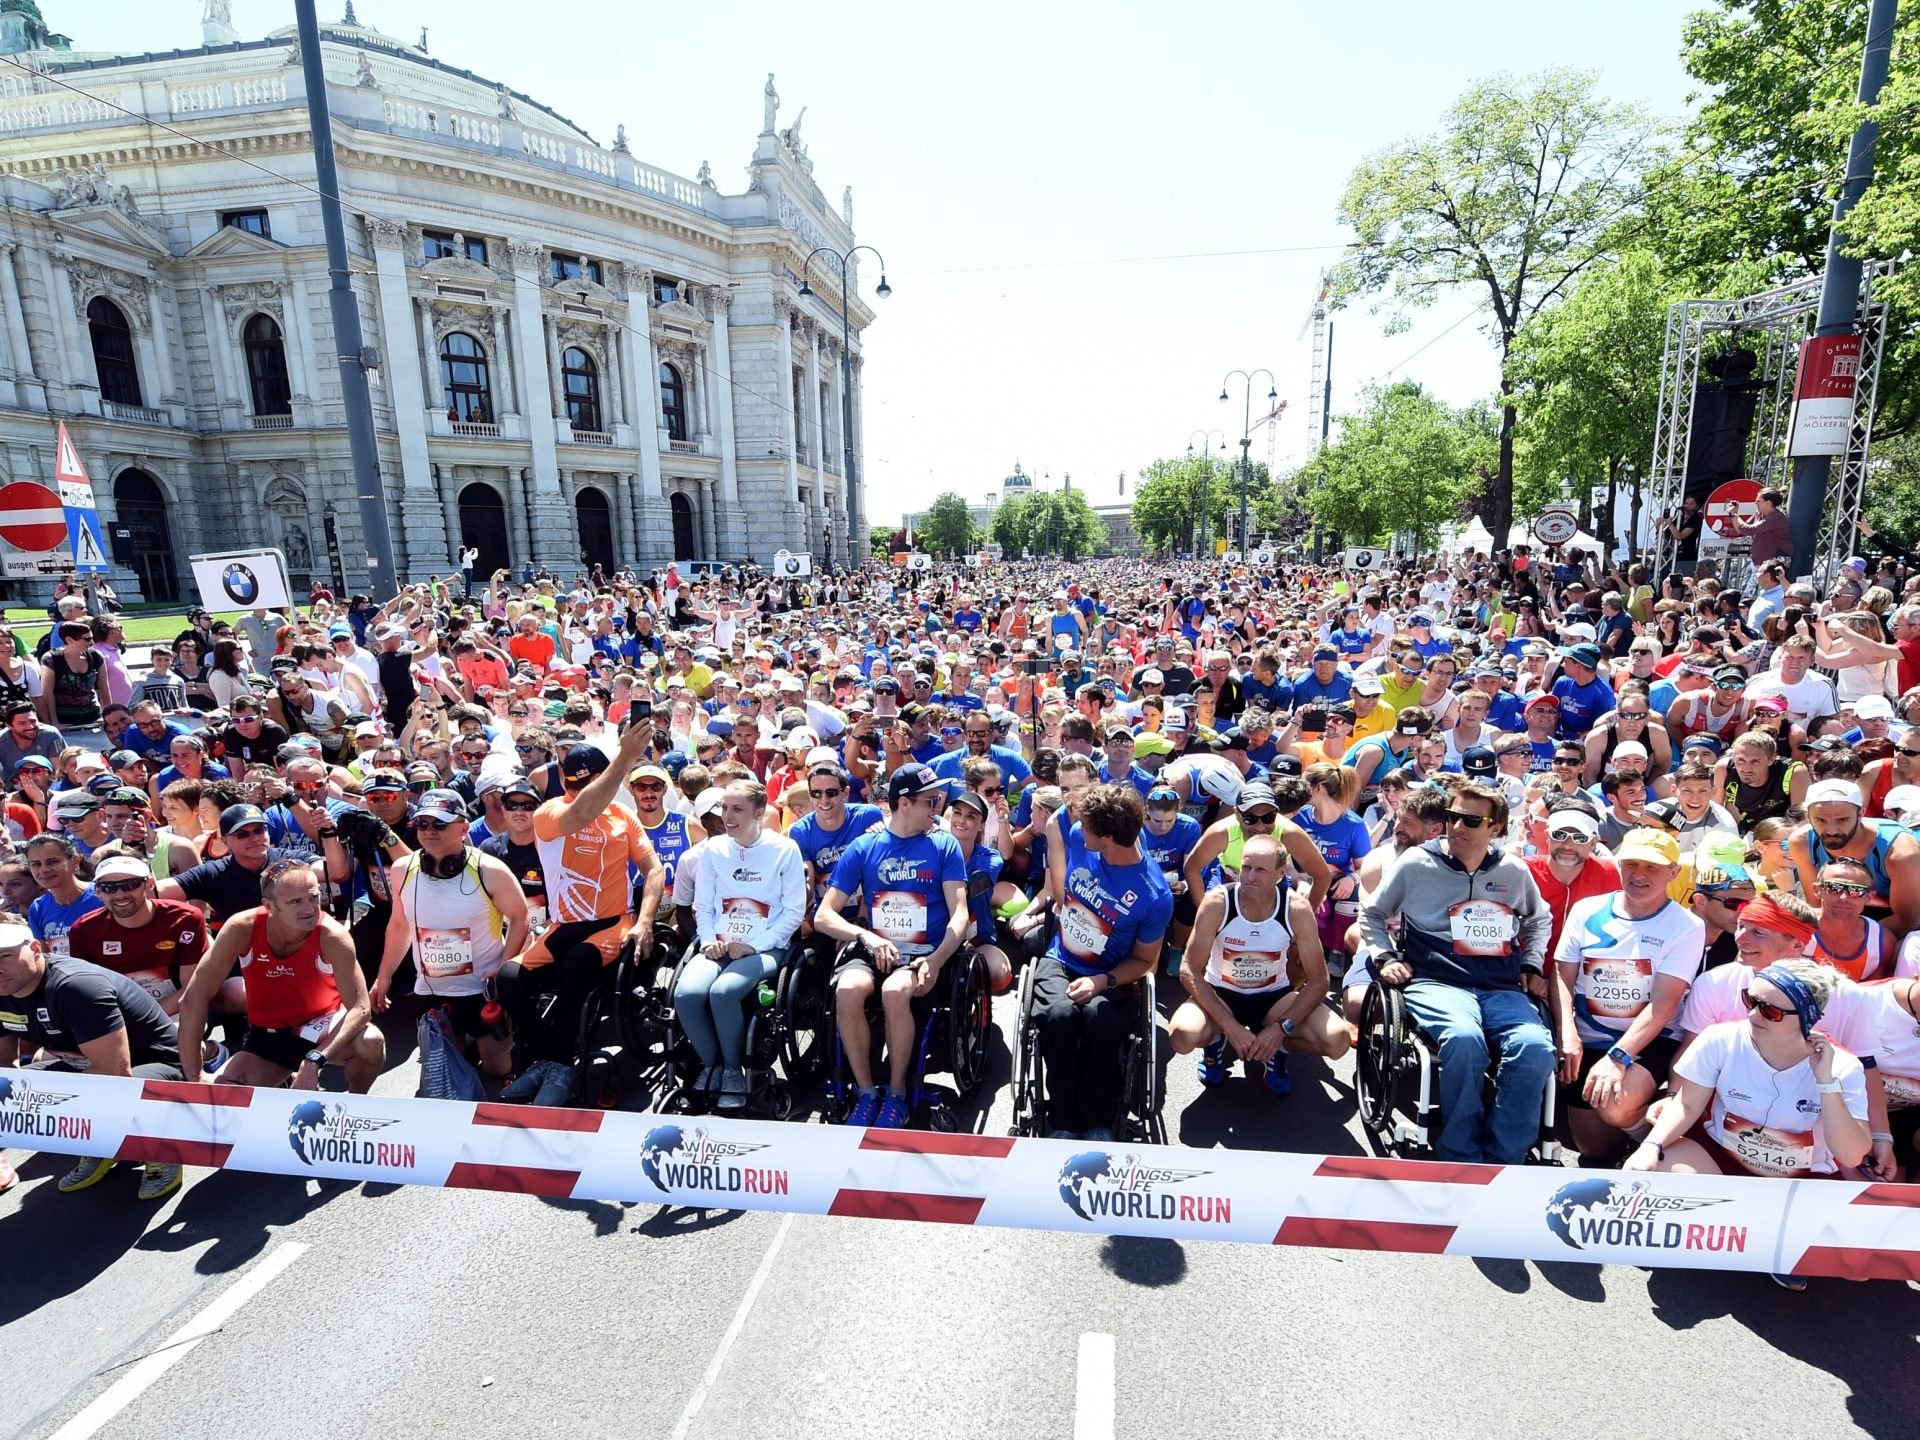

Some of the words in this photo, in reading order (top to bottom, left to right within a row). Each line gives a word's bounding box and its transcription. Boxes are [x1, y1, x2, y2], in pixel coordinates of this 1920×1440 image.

[1821, 378, 1856, 389] TEEHA
[7, 560, 36, 571] ausgen.
[224, 563, 252, 579] BMW
[823, 852, 841, 864] WORL
[889, 869, 917, 882] WORLD
[1074, 881, 1103, 909] WORLD
[727, 922, 754, 935] 7937
[883, 917, 913, 929] 2144
[1063, 919, 1095, 948] 91309
[1463, 925, 1503, 938] 76088
[423, 952, 462, 964] 20880
[1231, 968, 1268, 979] 25651
[1592, 986, 1641, 1001] 22956
[1602, 1002, 1633, 1011] Herbert
[13, 1089, 54, 1104] WINGS
[20, 1102, 43, 1114] LIFE
[0, 1110, 57, 1137] WORLD
[58, 1115, 92, 1141] RUN
[326, 1115, 372, 1130] WINGS
[333, 1127, 360, 1140] LIFE
[309, 1137, 375, 1165] WORLD
[377, 1142, 416, 1169] RUN
[684, 1140, 737, 1155] WINGS
[1736, 1143, 1797, 1167] 52146
[692, 1152, 723, 1166] LIFE
[665, 1162, 741, 1192] WORLD
[744, 1168, 789, 1196] RUN
[1111, 1166, 1173, 1182] WINGS
[1119, 1180, 1156, 1193] LIFE
[1086, 1189, 1176, 1220] WORLD
[1180, 1195, 1232, 1224] RUN
[1611, 1193, 1684, 1210] WINGS
[1617, 1206, 1660, 1221] LIFE
[1579, 1217, 1682, 1249] WORLD
[1685, 1223, 1748, 1253] RUN
